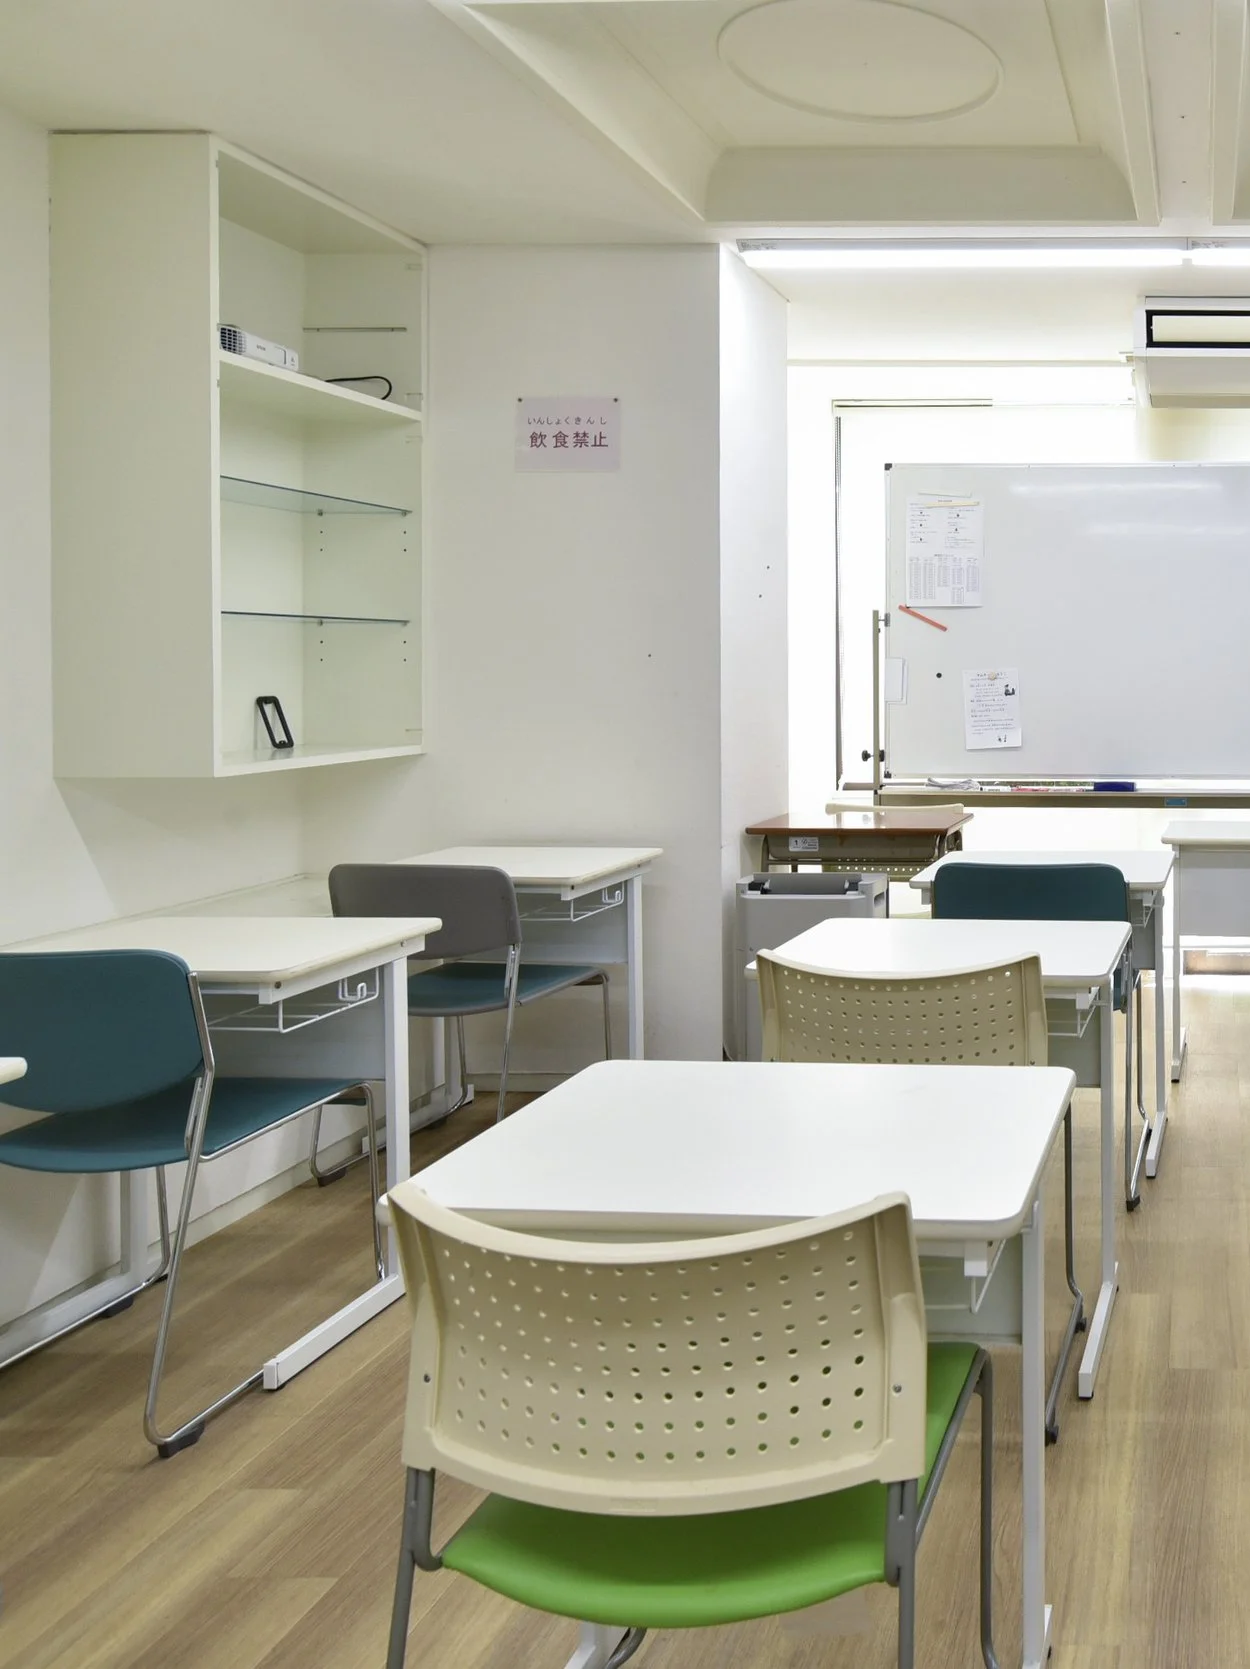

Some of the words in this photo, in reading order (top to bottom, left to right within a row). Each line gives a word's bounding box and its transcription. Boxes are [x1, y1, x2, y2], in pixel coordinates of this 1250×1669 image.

[527, 416, 608, 425] いんしょくきんし
[529, 430, 609, 449] 飲食禁止
